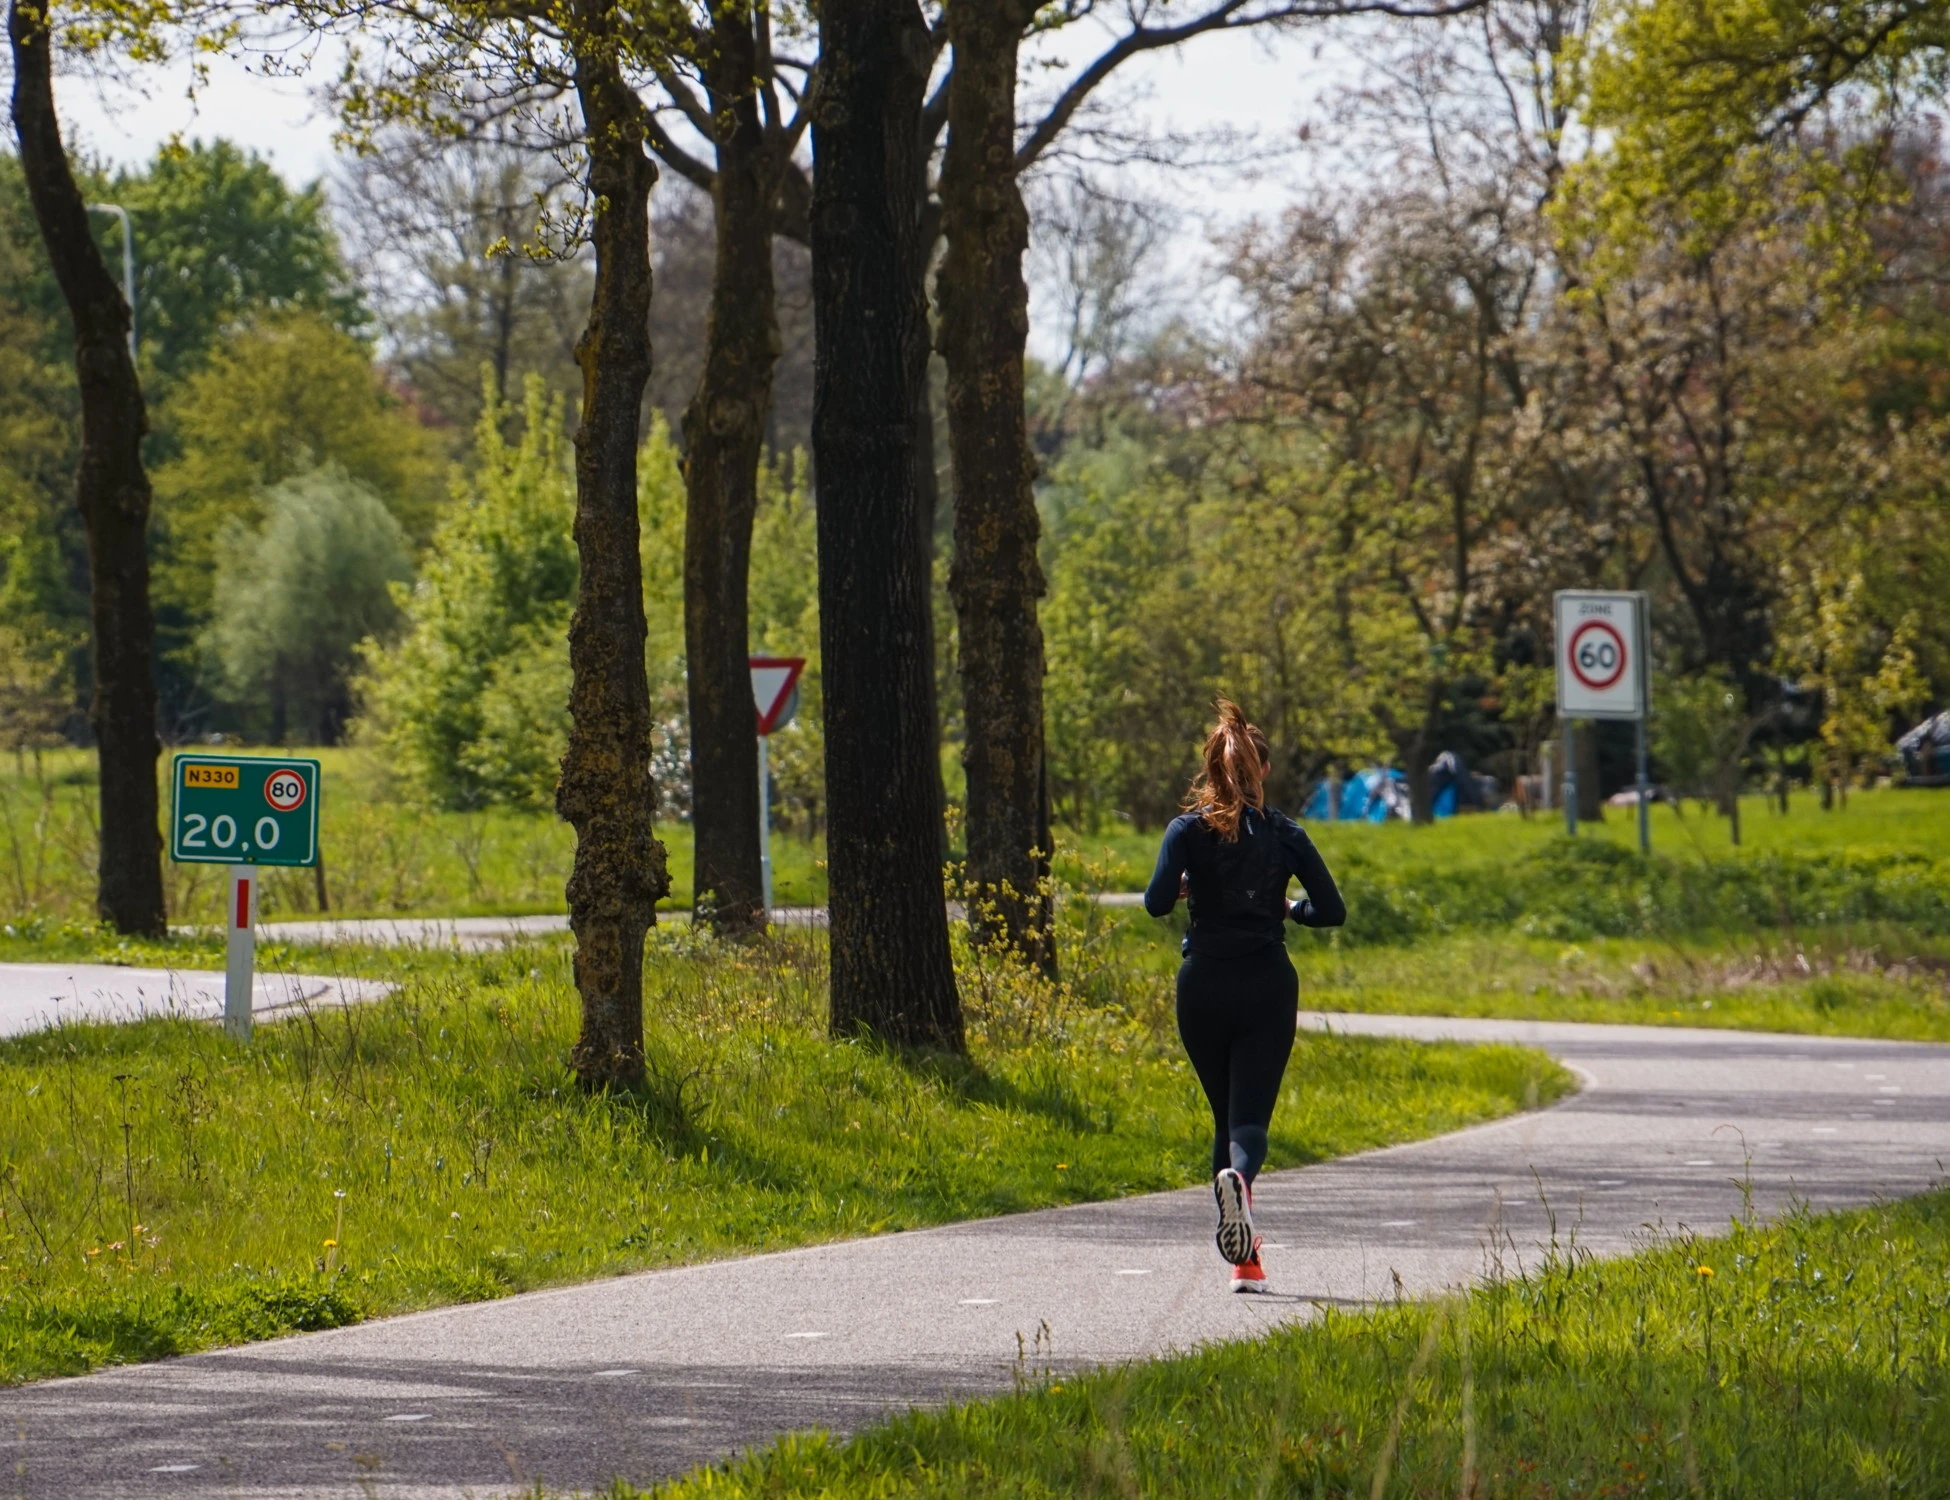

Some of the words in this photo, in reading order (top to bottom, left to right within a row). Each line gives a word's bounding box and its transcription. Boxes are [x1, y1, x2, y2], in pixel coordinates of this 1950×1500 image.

[1579, 602, 1612, 615] ZONE
[1580, 642, 1616, 668] 60
[189, 770, 235, 783] N330
[272, 782, 299, 798] 80
[182, 813, 280, 852] 20,0
